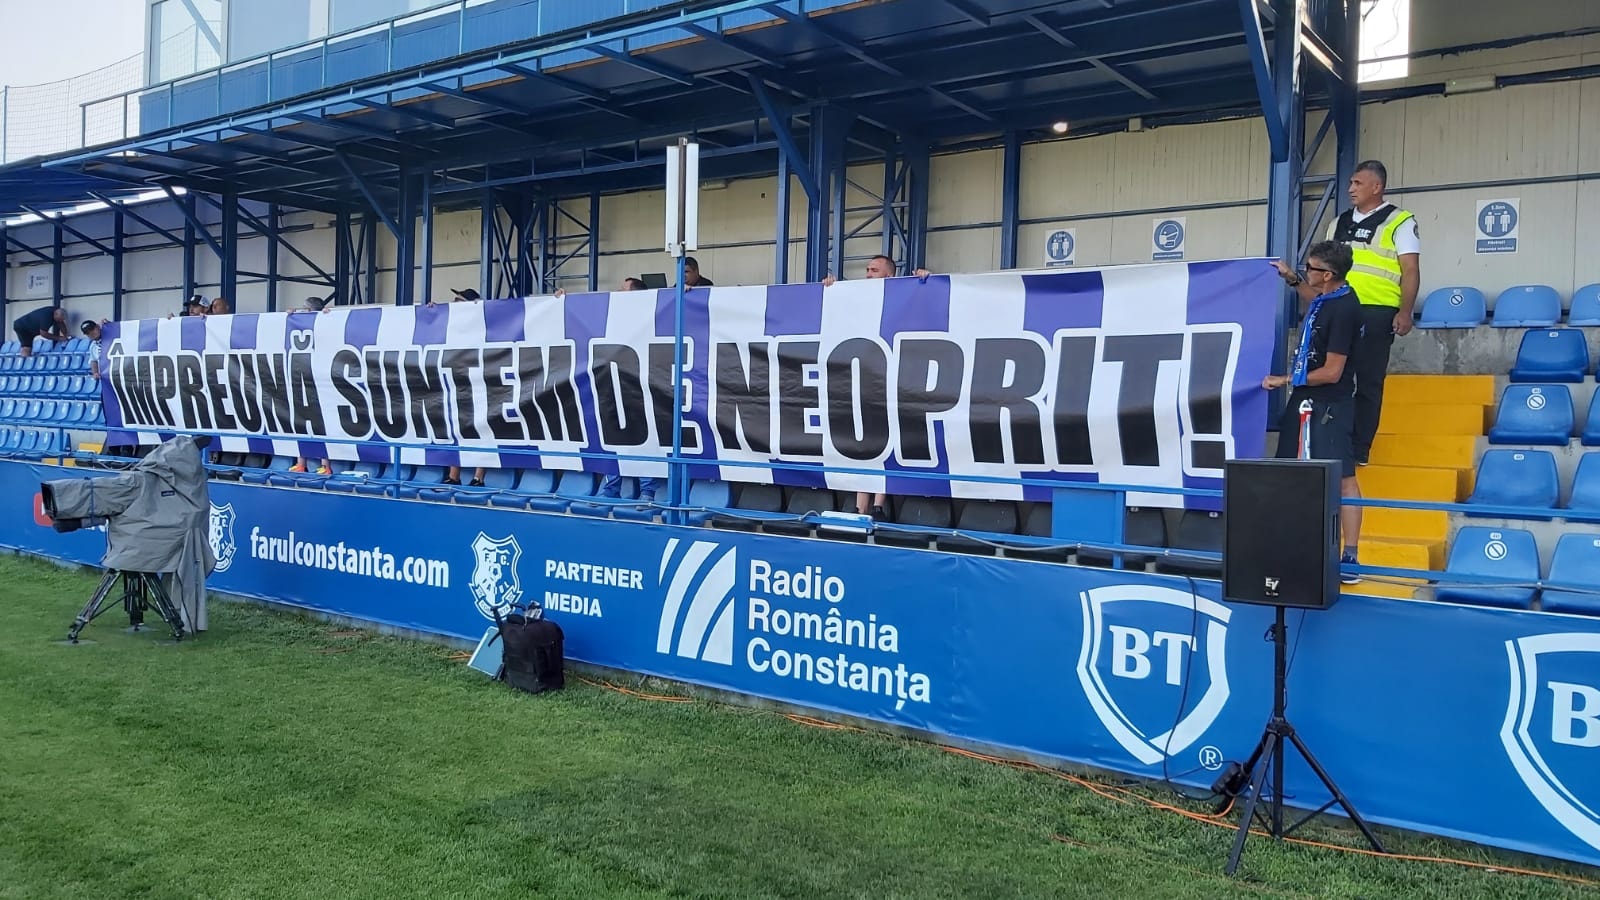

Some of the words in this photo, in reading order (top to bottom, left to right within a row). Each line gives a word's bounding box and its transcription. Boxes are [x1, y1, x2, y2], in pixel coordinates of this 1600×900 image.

[109, 333, 327, 437] ÎMPREUNĂ
[331, 345, 584, 442] SUNTEM
[592, 342, 699, 448] DE
[715, 332, 1230, 469] NEOPRIT!
[250, 526, 449, 588] farulconstanta.com
[545, 559, 643, 590] PARTENER
[749, 559, 845, 603] Radio
[544, 591, 602, 618] MEDIA
[748, 607, 898, 653] România
[746, 637, 931, 711] Constanța
[1109, 624, 1197, 686] BT
